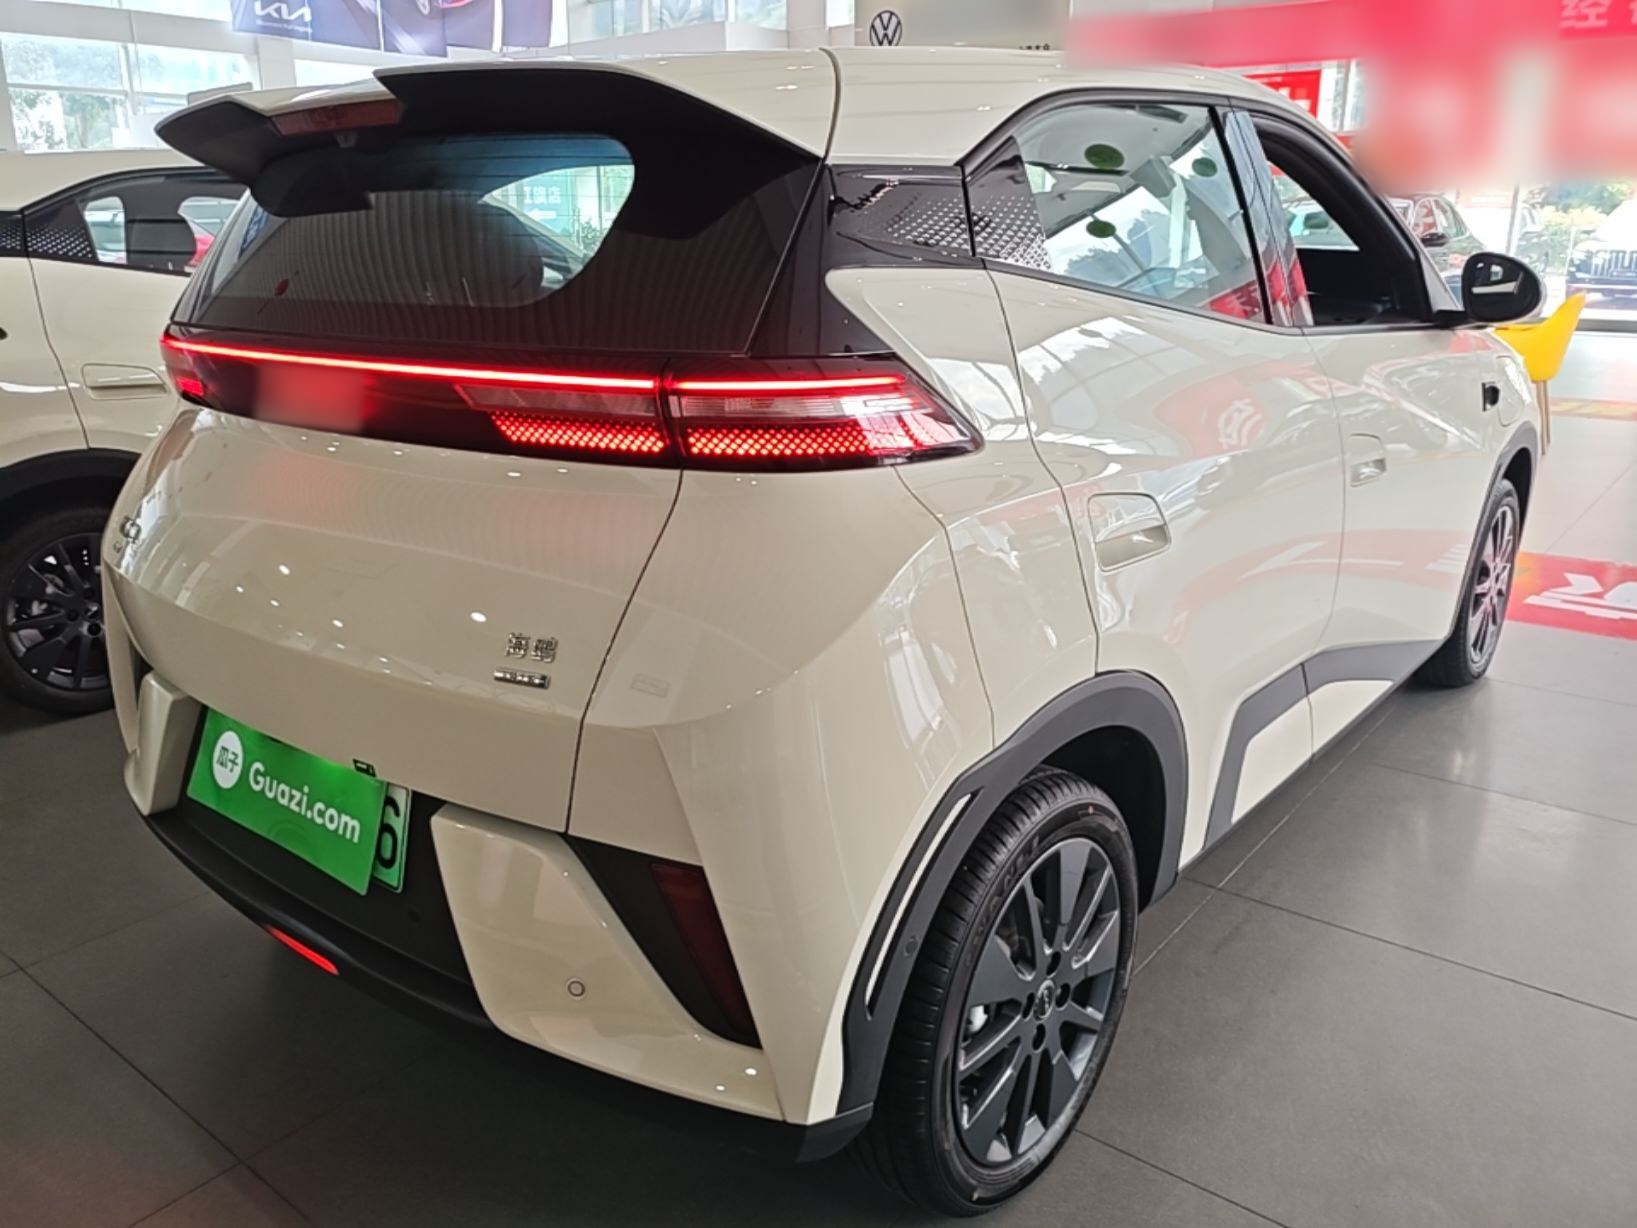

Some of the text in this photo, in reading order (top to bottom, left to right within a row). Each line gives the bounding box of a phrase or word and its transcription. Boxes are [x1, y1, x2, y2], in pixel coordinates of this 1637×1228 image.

[1558, 0, 1637, 29] 经
[215, 745, 239, 773] 瓜子
[249, 761, 361, 844] Guazi.com
[376, 795, 401, 870] 6
